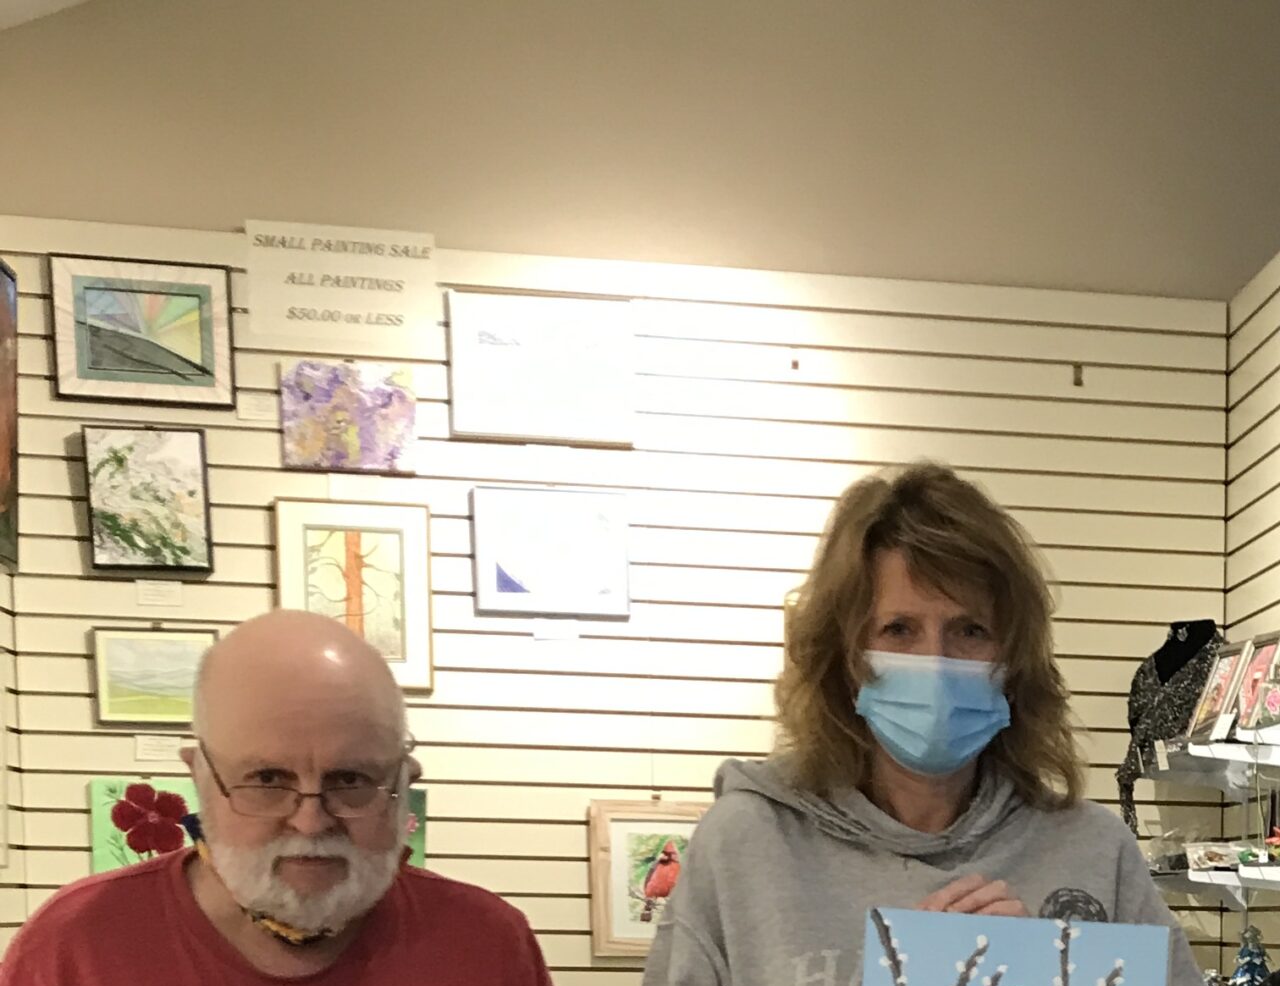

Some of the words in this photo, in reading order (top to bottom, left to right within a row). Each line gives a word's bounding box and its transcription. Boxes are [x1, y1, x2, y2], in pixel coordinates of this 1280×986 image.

[253, 234, 306, 251] SMALL
[311, 238, 385, 255] PAINTING
[389, 244, 431, 259] SALE
[285, 272, 315, 286] ALL
[320, 274, 405, 292] PAINTINGS
[286, 307, 341, 322] $50.00
[365, 312, 404, 326] LESS
